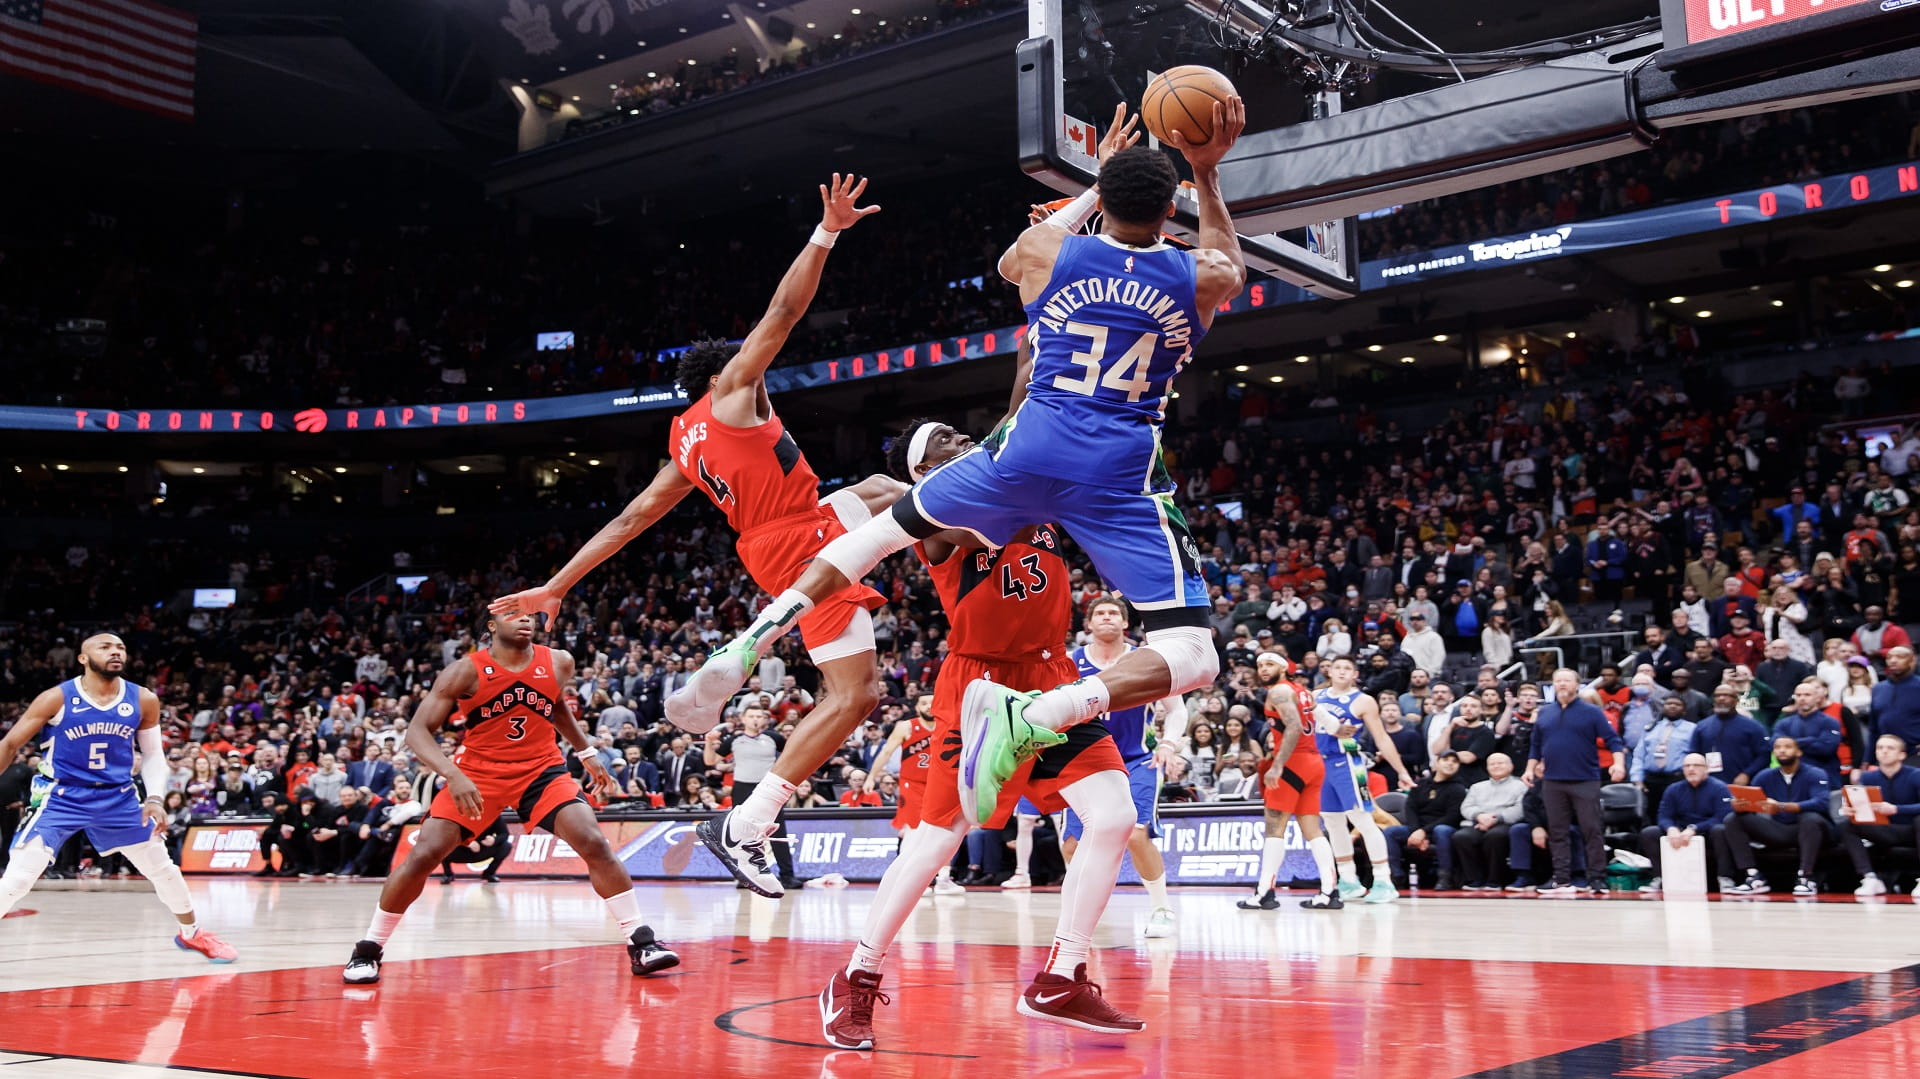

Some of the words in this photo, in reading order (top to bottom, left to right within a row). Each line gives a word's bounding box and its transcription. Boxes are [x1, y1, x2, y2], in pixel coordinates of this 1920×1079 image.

[1468, 232, 1562, 262] Tangerine
[1038, 277, 1192, 349] ANTETOKOUNMPO
[828, 333, 996, 381] TORONTO
[1052, 320, 1159, 403] 34
[75, 411, 274, 430] TORONTO
[347, 401, 526, 429] RAPTORS
[679, 422, 707, 468] BARNES
[698, 455, 735, 506] 4
[1002, 553, 1048, 601] 43
[480, 687, 553, 718] RAPTORS
[64, 721, 135, 741] MILWAUKEE
[505, 716, 527, 741] 3
[88, 742, 109, 770] 5
[513, 834, 554, 862] NEXT
[799, 832, 846, 863] NEXT
[847, 837, 899, 858] ESP
[1198, 821, 1266, 852] LAKERS
[1177, 855, 1261, 877] ESPN
